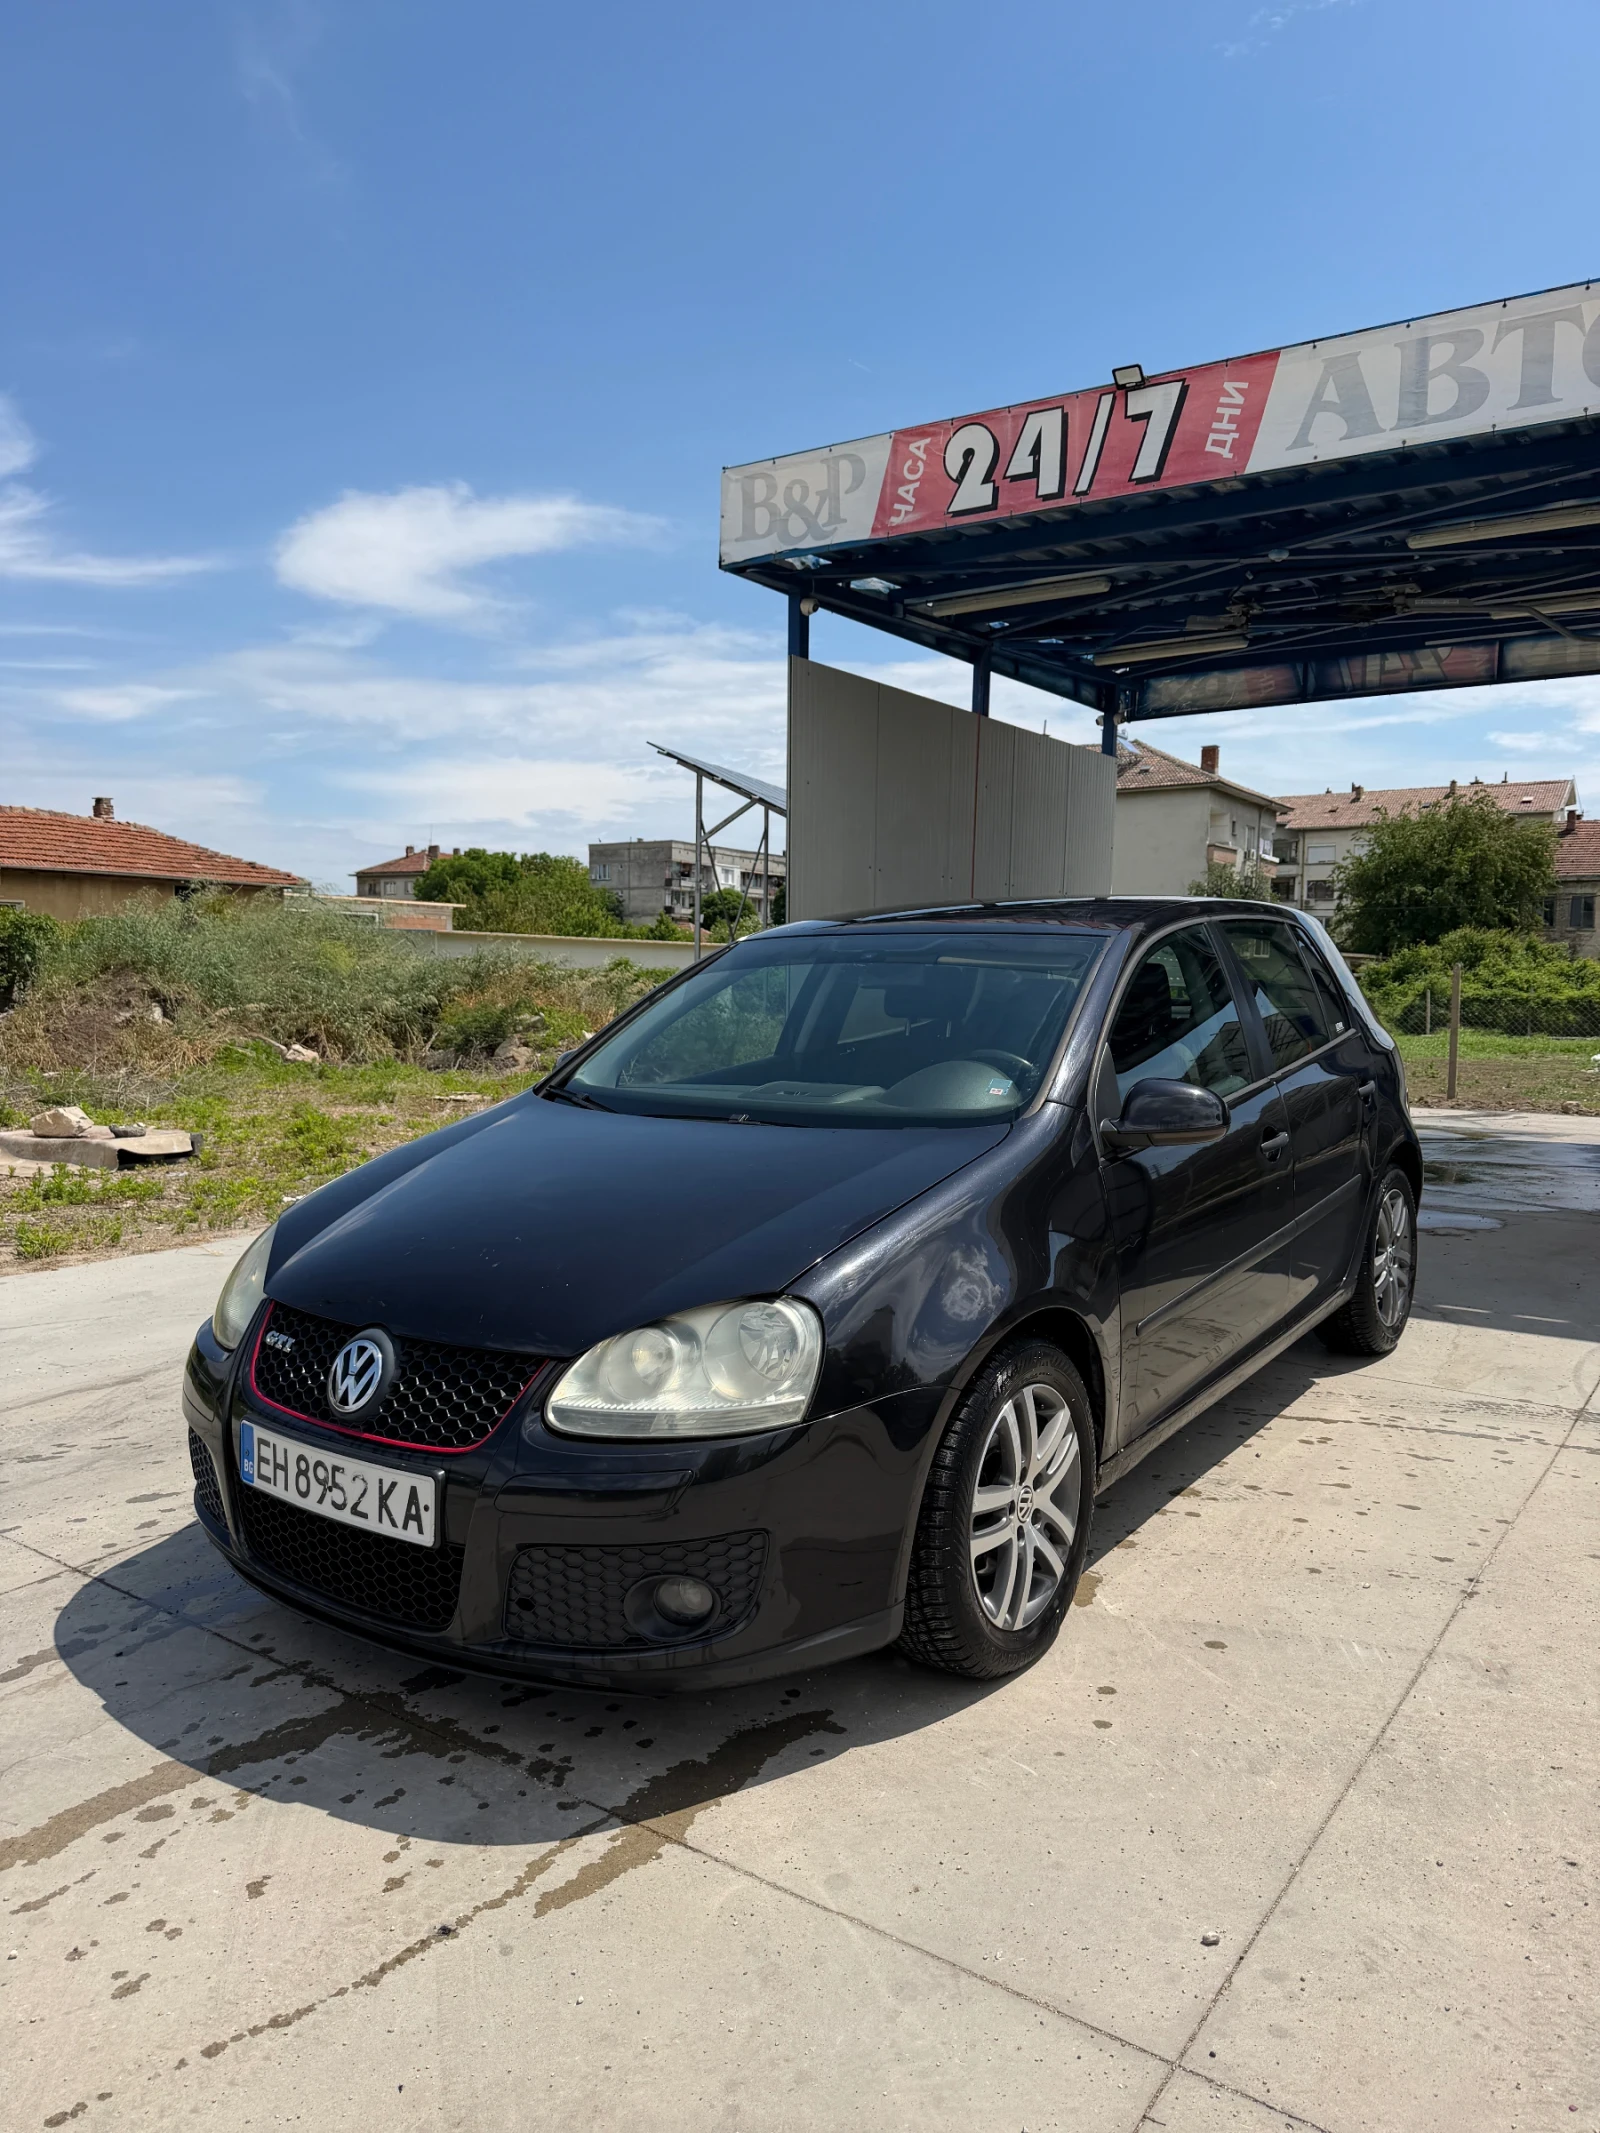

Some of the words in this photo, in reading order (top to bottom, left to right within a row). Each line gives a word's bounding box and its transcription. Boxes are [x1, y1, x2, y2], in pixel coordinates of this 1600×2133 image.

[1285, 304, 1600, 451] АВТ
[943, 378, 1191, 518] 24/7
[1204, 381, 1249, 459] ДНИ
[735, 453, 867, 546] B&P
[888, 437, 931, 526] ЧАСА
[265, 1330, 296, 1353] GTI
[327, 1338, 383, 1413] VW
[243, 1458, 254, 1474] BG
